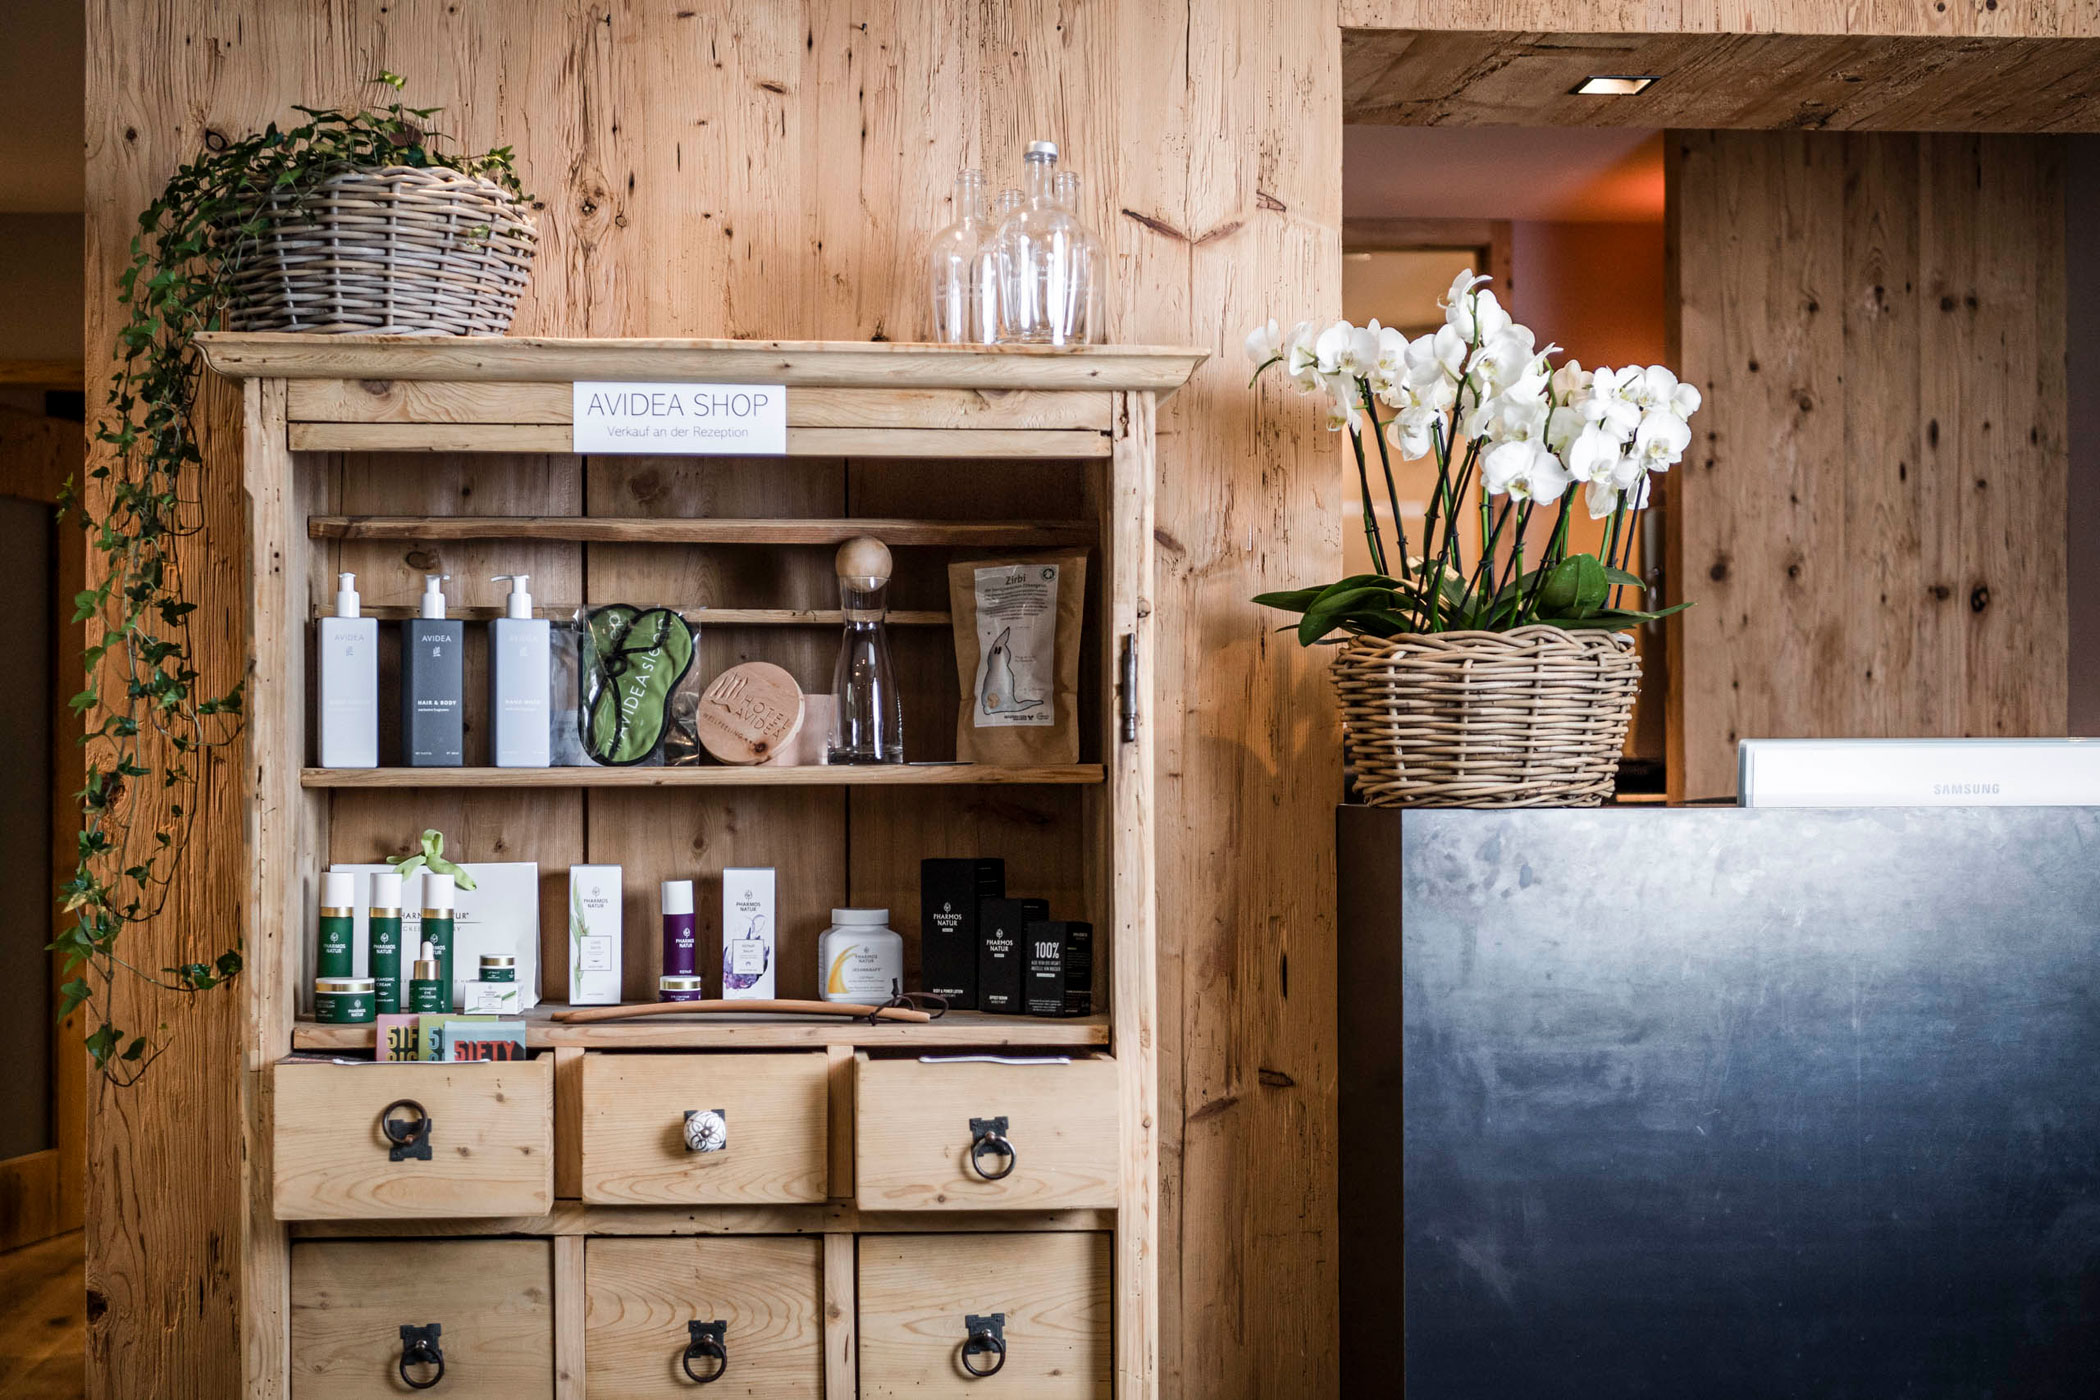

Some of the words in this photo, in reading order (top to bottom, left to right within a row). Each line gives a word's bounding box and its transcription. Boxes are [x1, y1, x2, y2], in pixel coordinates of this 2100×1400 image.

[587, 392, 685, 417] AVIDEA
[693, 392, 769, 417] SHOP
[606, 425, 650, 438] Verkauf
[652, 428, 667, 438] an
[669, 426, 690, 438] der
[692, 426, 749, 440] Rezeption
[1004, 573, 1026, 586] Zirbi
[334, 633, 365, 642] AVIDEA
[421, 634, 452, 643] AVIDEA
[741, 694, 791, 731] HOTEL
[734, 707, 781, 741] AVIDEA
[1933, 783, 2000, 796] SAMSUNG
[1034, 941, 1060, 959] 100%
